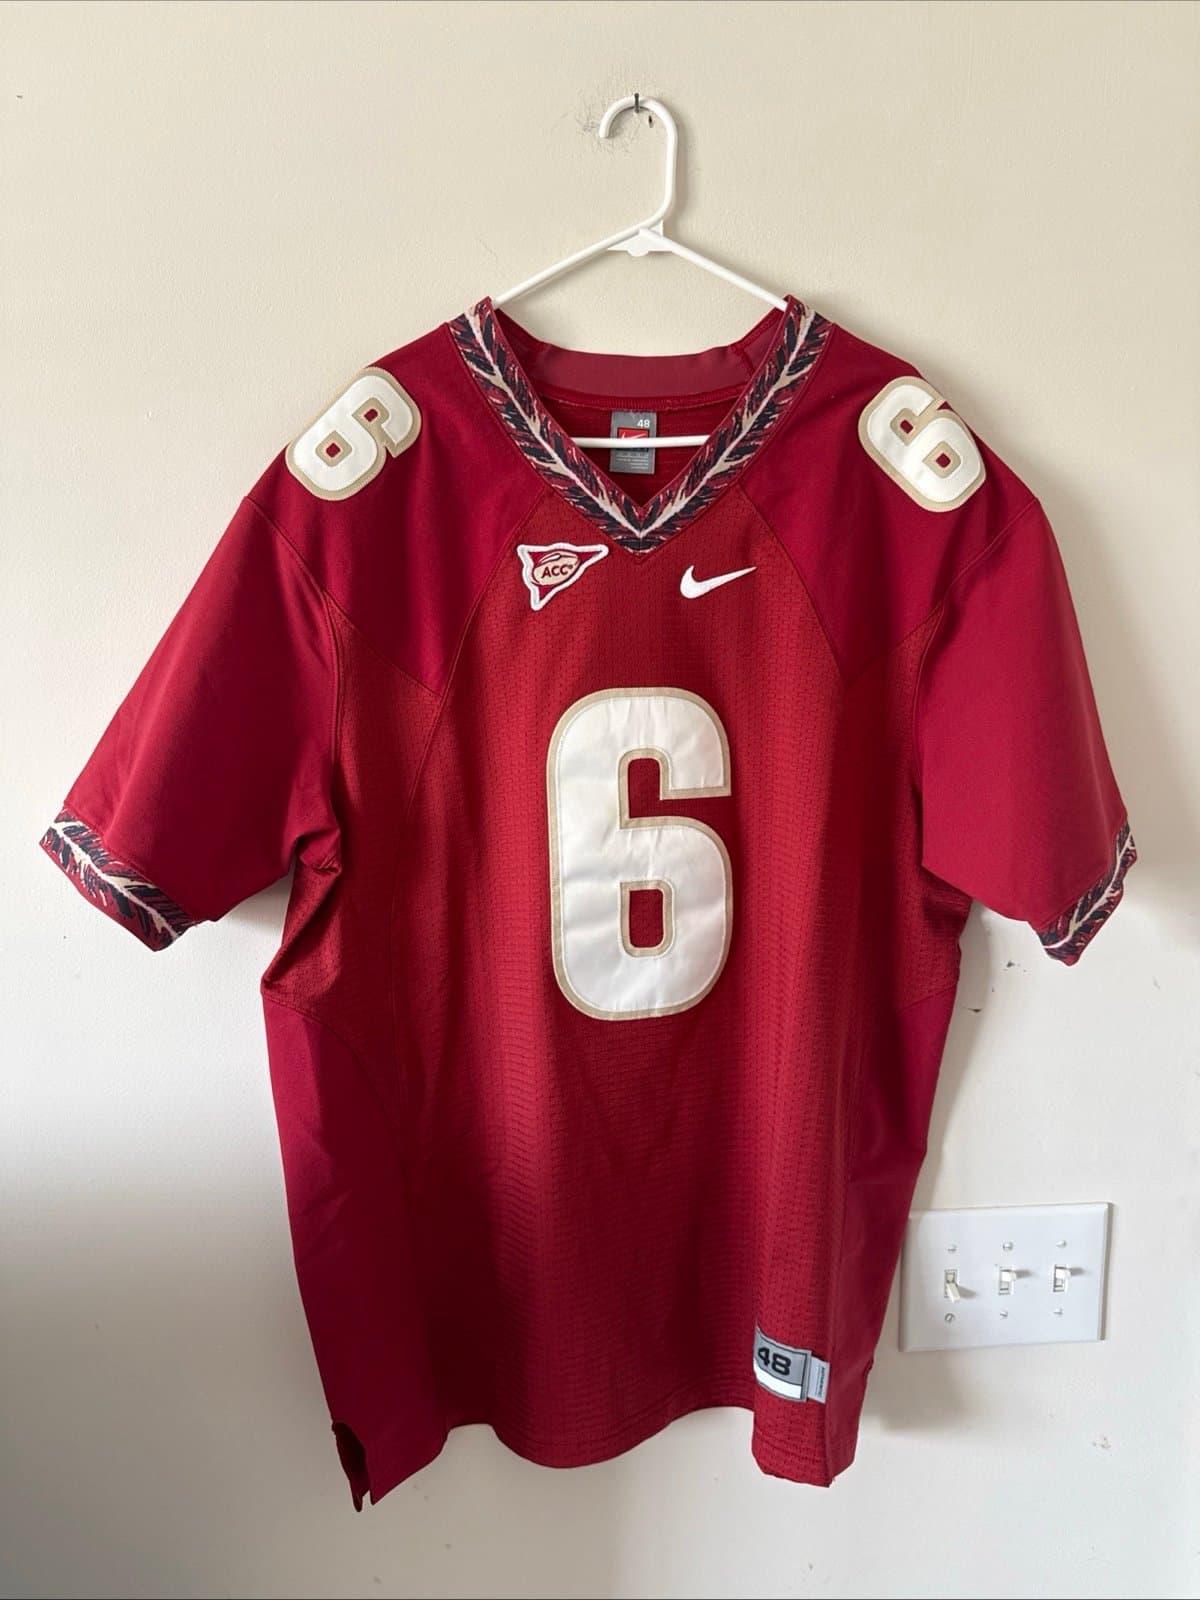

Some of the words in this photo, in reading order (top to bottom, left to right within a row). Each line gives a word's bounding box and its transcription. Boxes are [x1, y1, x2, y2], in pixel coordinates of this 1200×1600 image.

[285, 366, 422, 501] 6
[637, 419, 650, 428] 48
[858, 376, 987, 513] 6
[546, 686, 733, 1021] 6
[757, 1347, 792, 1376] 48
